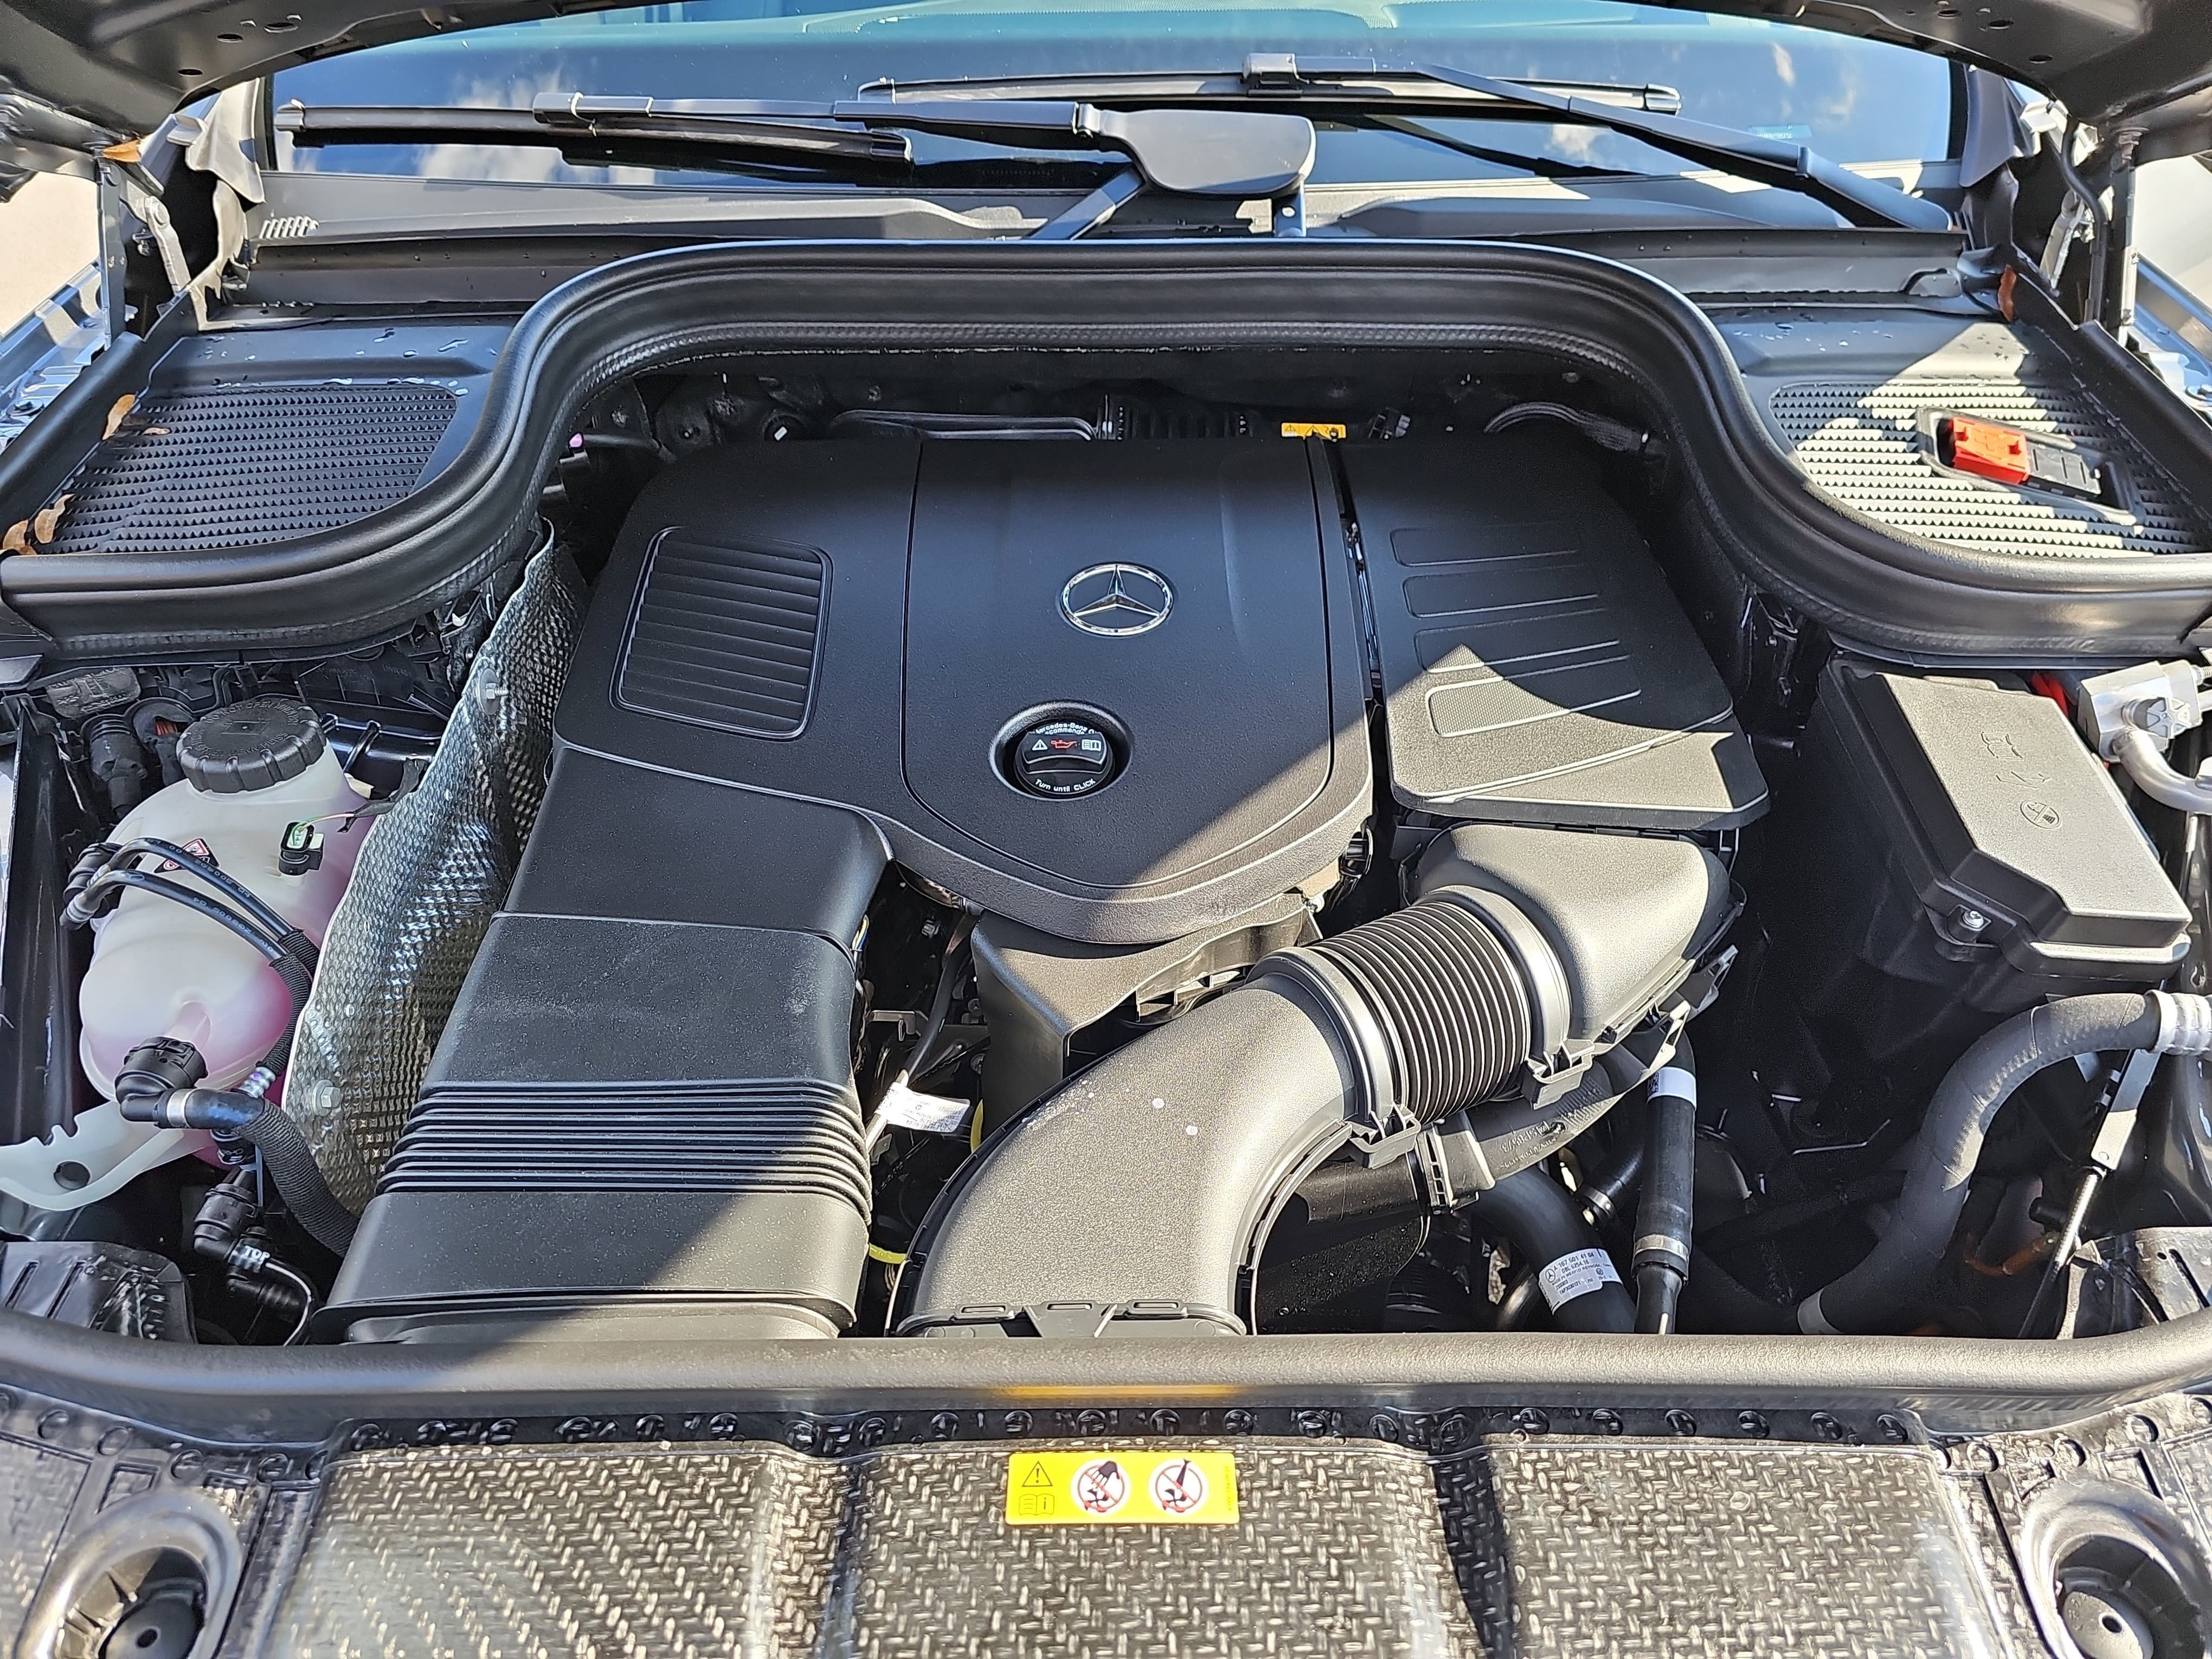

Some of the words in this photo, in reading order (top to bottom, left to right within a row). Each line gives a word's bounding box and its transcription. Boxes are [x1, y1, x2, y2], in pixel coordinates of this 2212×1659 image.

[246, 700, 274, 709] OPEN
[1035, 779, 1051, 790] Turn
[1073, 778, 1096, 790] CLICK
[245, 1245, 271, 1261] TOP
[1559, 1259, 1567, 1268] 167
